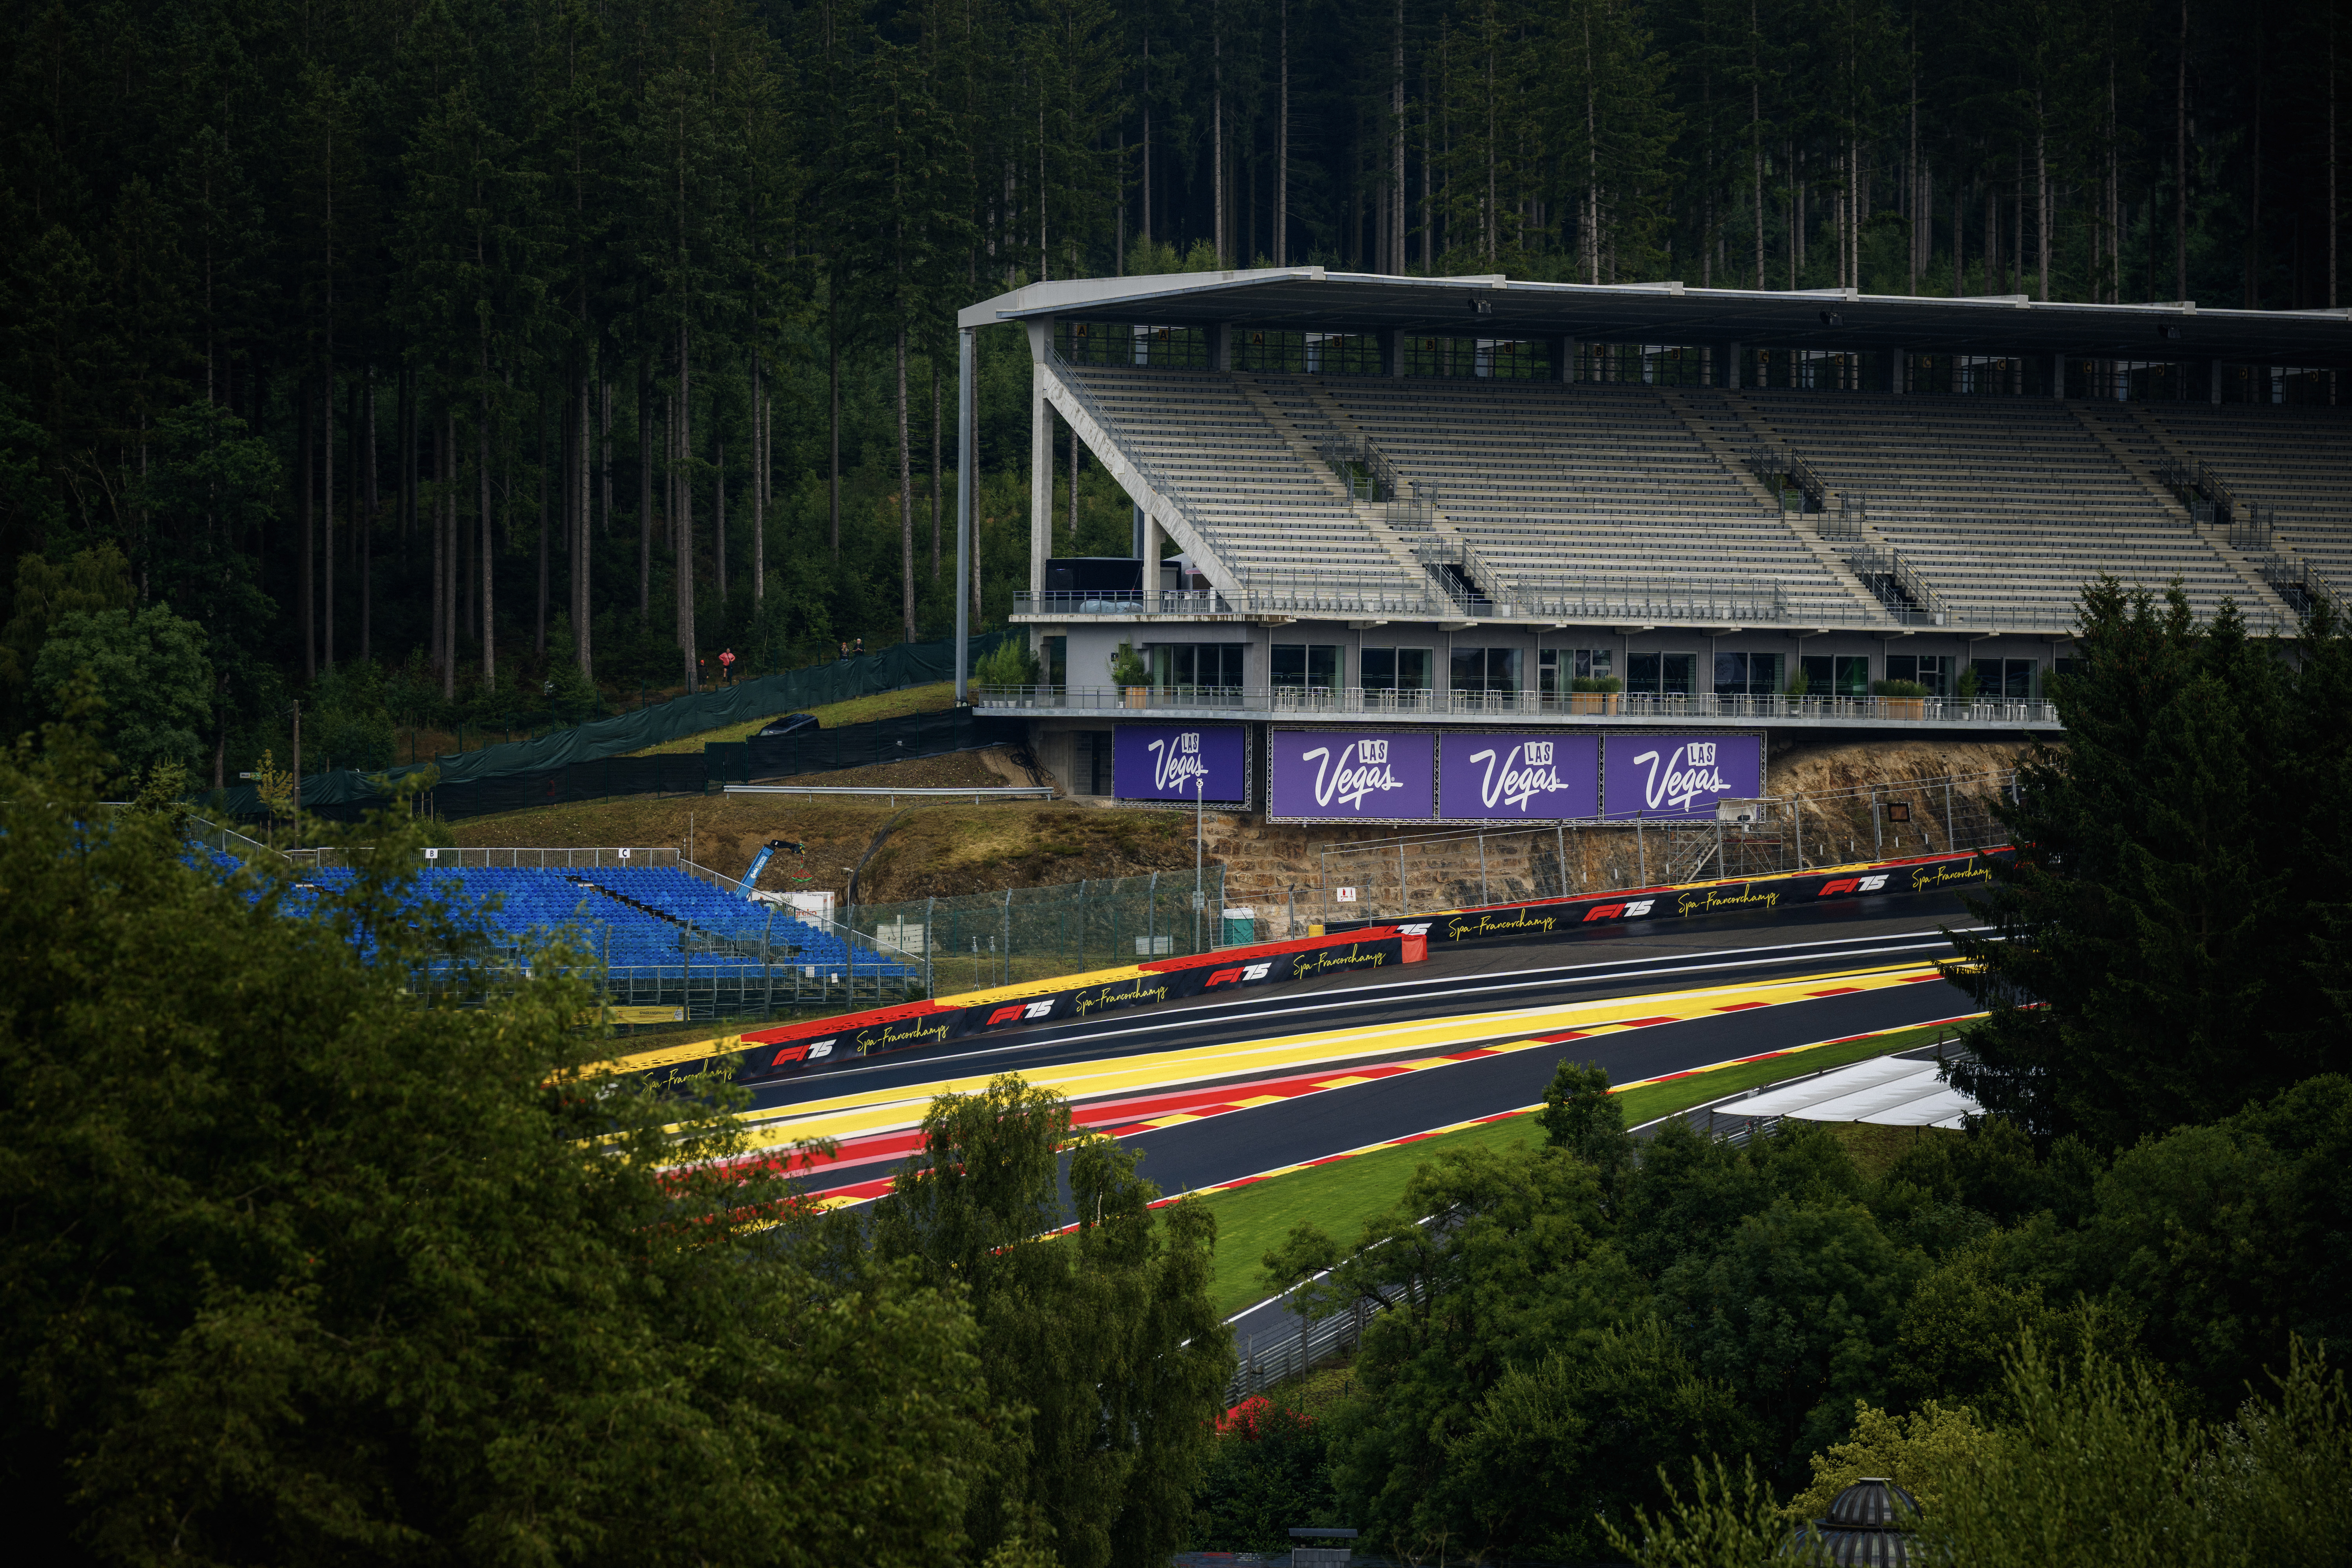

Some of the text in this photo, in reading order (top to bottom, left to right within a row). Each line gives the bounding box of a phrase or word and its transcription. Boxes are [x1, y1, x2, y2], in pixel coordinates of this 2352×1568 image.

[1078, 326, 1086, 336] A
[1160, 330, 1168, 340] A
[1254, 334, 1262, 344] A
[1334, 337, 1340, 347] B
[1427, 340, 1434, 350] B
[1506, 343, 1512, 352] B
[1596, 346, 1602, 356] B
[1673, 349, 1679, 359] B
[1762, 352, 1768, 362] C
[1837, 355, 1843, 365] C
[1924, 358, 1930, 367] C
[1998, 359, 2005, 369] C
[2085, 362, 2091, 372] C
[2157, 365, 2163, 375] D
[2240, 368, 2247, 378] D
[1182, 734, 1198, 752] LAS
[1360, 741, 1386, 762] LAS
[1526, 743, 1552, 763] LAS
[1689, 744, 1714, 764] LAS
[622, 849, 627, 857] C
[757, 856, 765, 866] RENTAL
[751, 867, 759, 878] Collé
[1678, 883, 1780, 917] Spa-Francorchamps
[1449, 908, 1556, 941] Spa-Francorchamps
[1294, 943, 1386, 979] Spa-Francorchamps
[1076, 978, 1168, 1016] Spa-Francorchamps
[857, 1017, 949, 1056] Spa-Francorchamps
